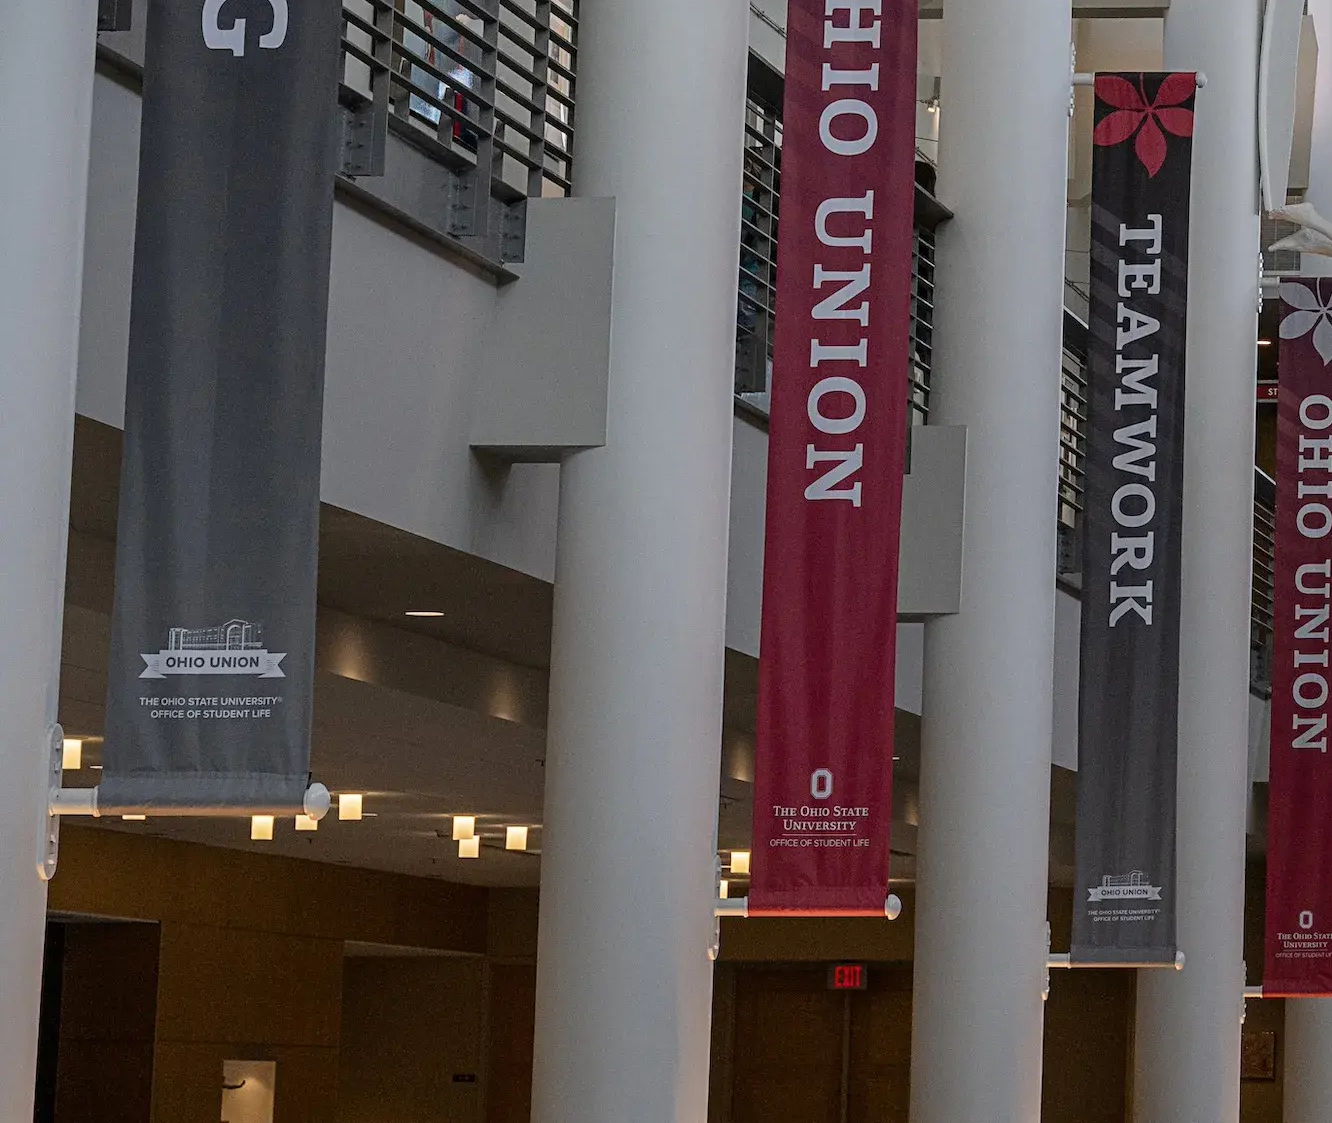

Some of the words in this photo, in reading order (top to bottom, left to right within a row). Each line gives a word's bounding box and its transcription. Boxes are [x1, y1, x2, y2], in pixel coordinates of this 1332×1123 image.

[804, 189, 874, 508] UNION
[1108, 213, 1163, 628] TEAMWORK
[1291, 558, 1332, 753] UNION
[166, 656, 205, 668] OHIO
[210, 656, 260, 668] UNION
[139, 697, 159, 706] THE
[161, 697, 186, 706] OHIO
[188, 697, 218, 706] STATE
[150, 709, 184, 719] OFFICE
[187, 709, 200, 719] OF
[203, 709, 250, 718] STUDENT
[252, 709, 270, 718] LIFE
[810, 768, 834, 800] O
[772, 806, 797, 816] THE
[800, 806, 830, 816] OHIO
[833, 806, 869, 816] STATE
[783, 819, 857, 831] UNIVERSITY
[770, 838, 798, 848] OFFICE
[800, 838, 812, 848] OF
[814, 838, 850, 847] STUDENT
[853, 838, 870, 847] LIFE
[834, 965, 862, 988] EXIT
